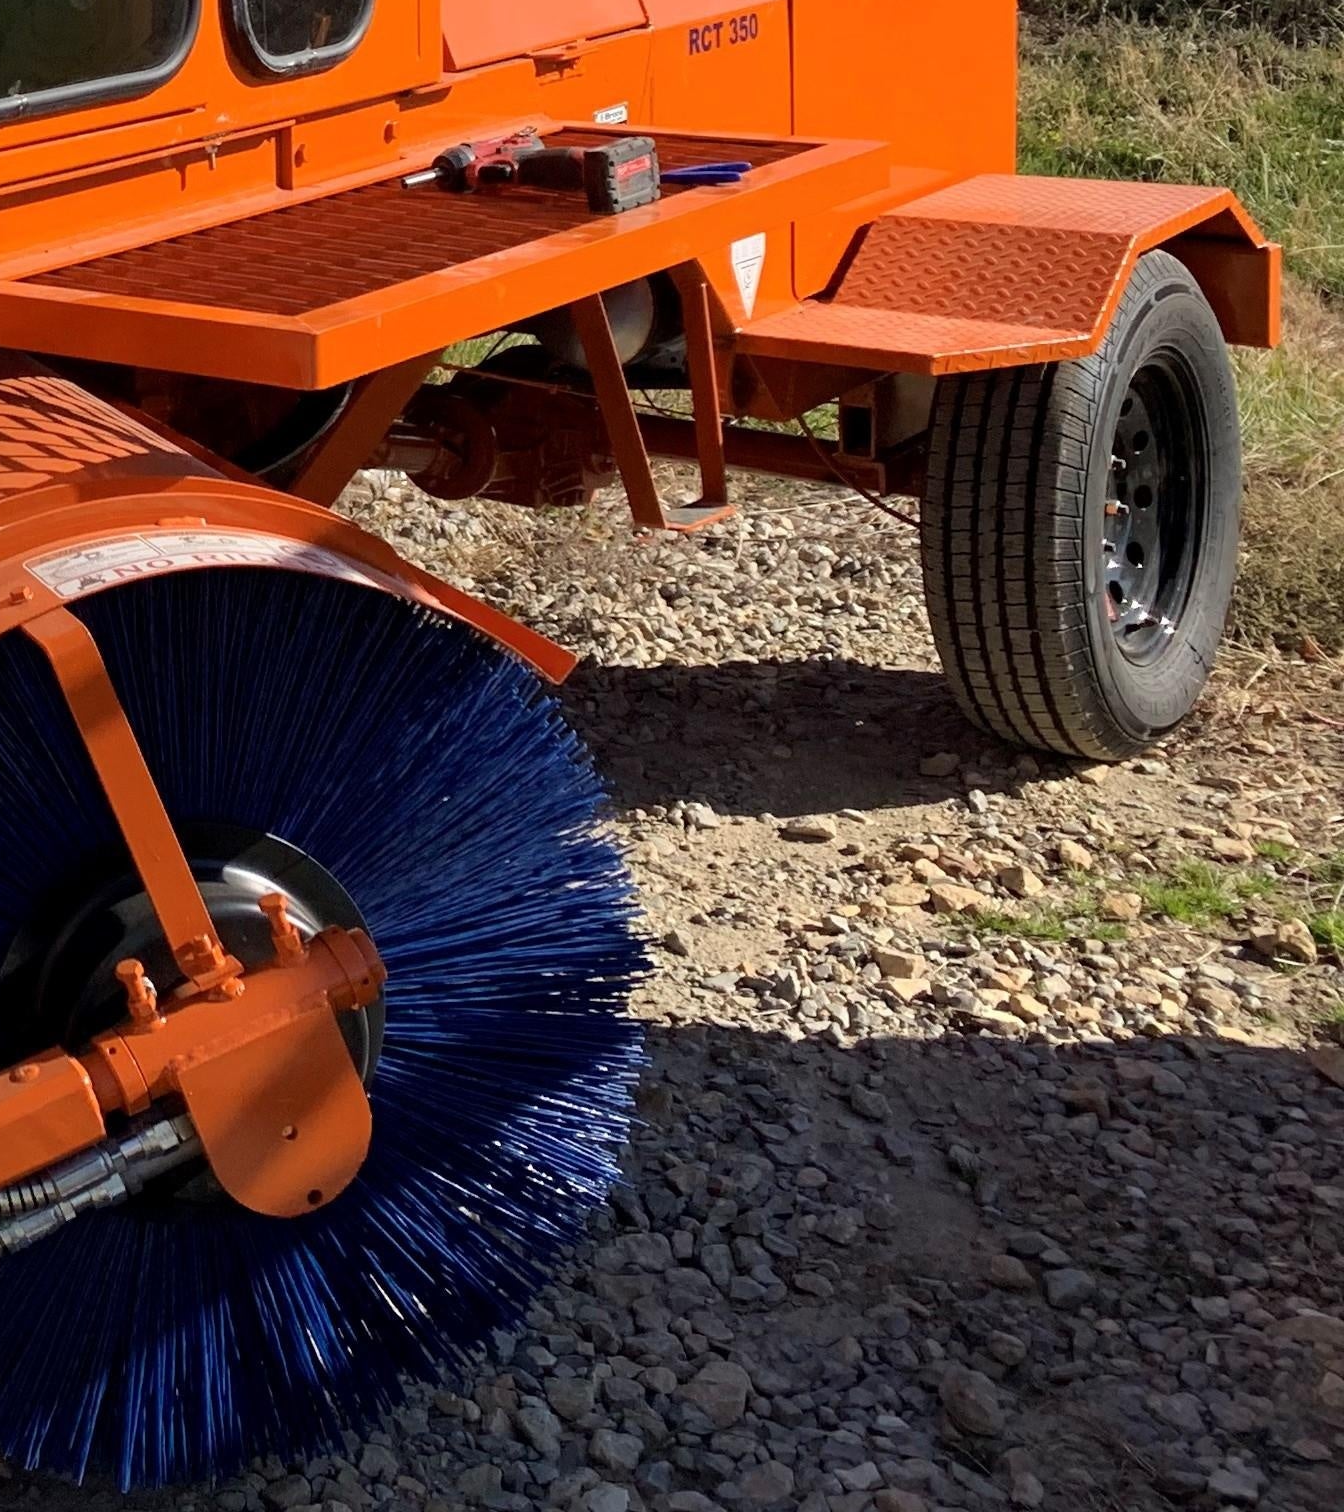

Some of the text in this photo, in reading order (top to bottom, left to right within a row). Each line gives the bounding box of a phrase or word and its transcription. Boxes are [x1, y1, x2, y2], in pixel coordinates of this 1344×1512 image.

[689, 13, 759, 55] RCT 350
[113, 558, 175, 579] NO
